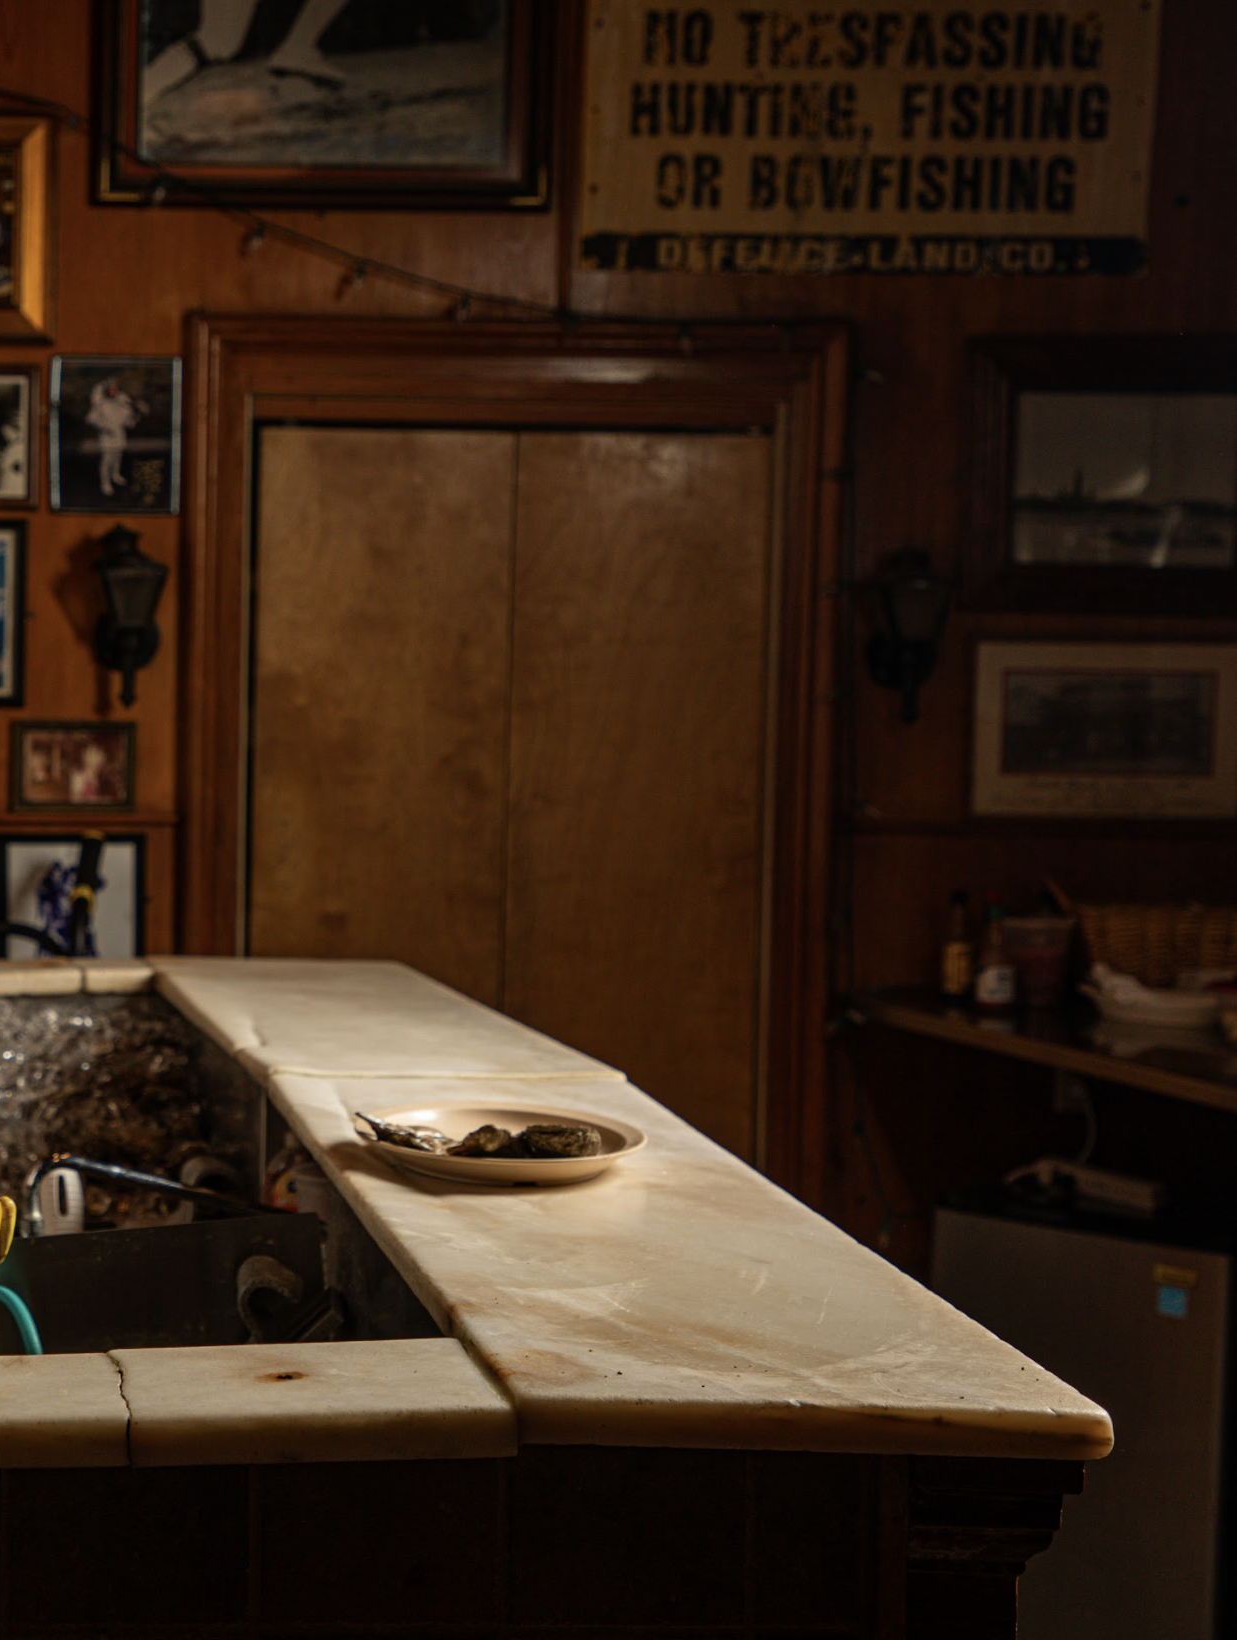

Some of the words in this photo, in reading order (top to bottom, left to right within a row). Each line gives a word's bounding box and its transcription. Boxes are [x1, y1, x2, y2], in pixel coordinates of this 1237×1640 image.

[644, 10, 712, 67] NO
[901, 83, 1110, 140] FISHING
[657, 153, 722, 209] OR
[750, 153, 1076, 212] BOWFISHING
[867, 236, 979, 272] LAND
